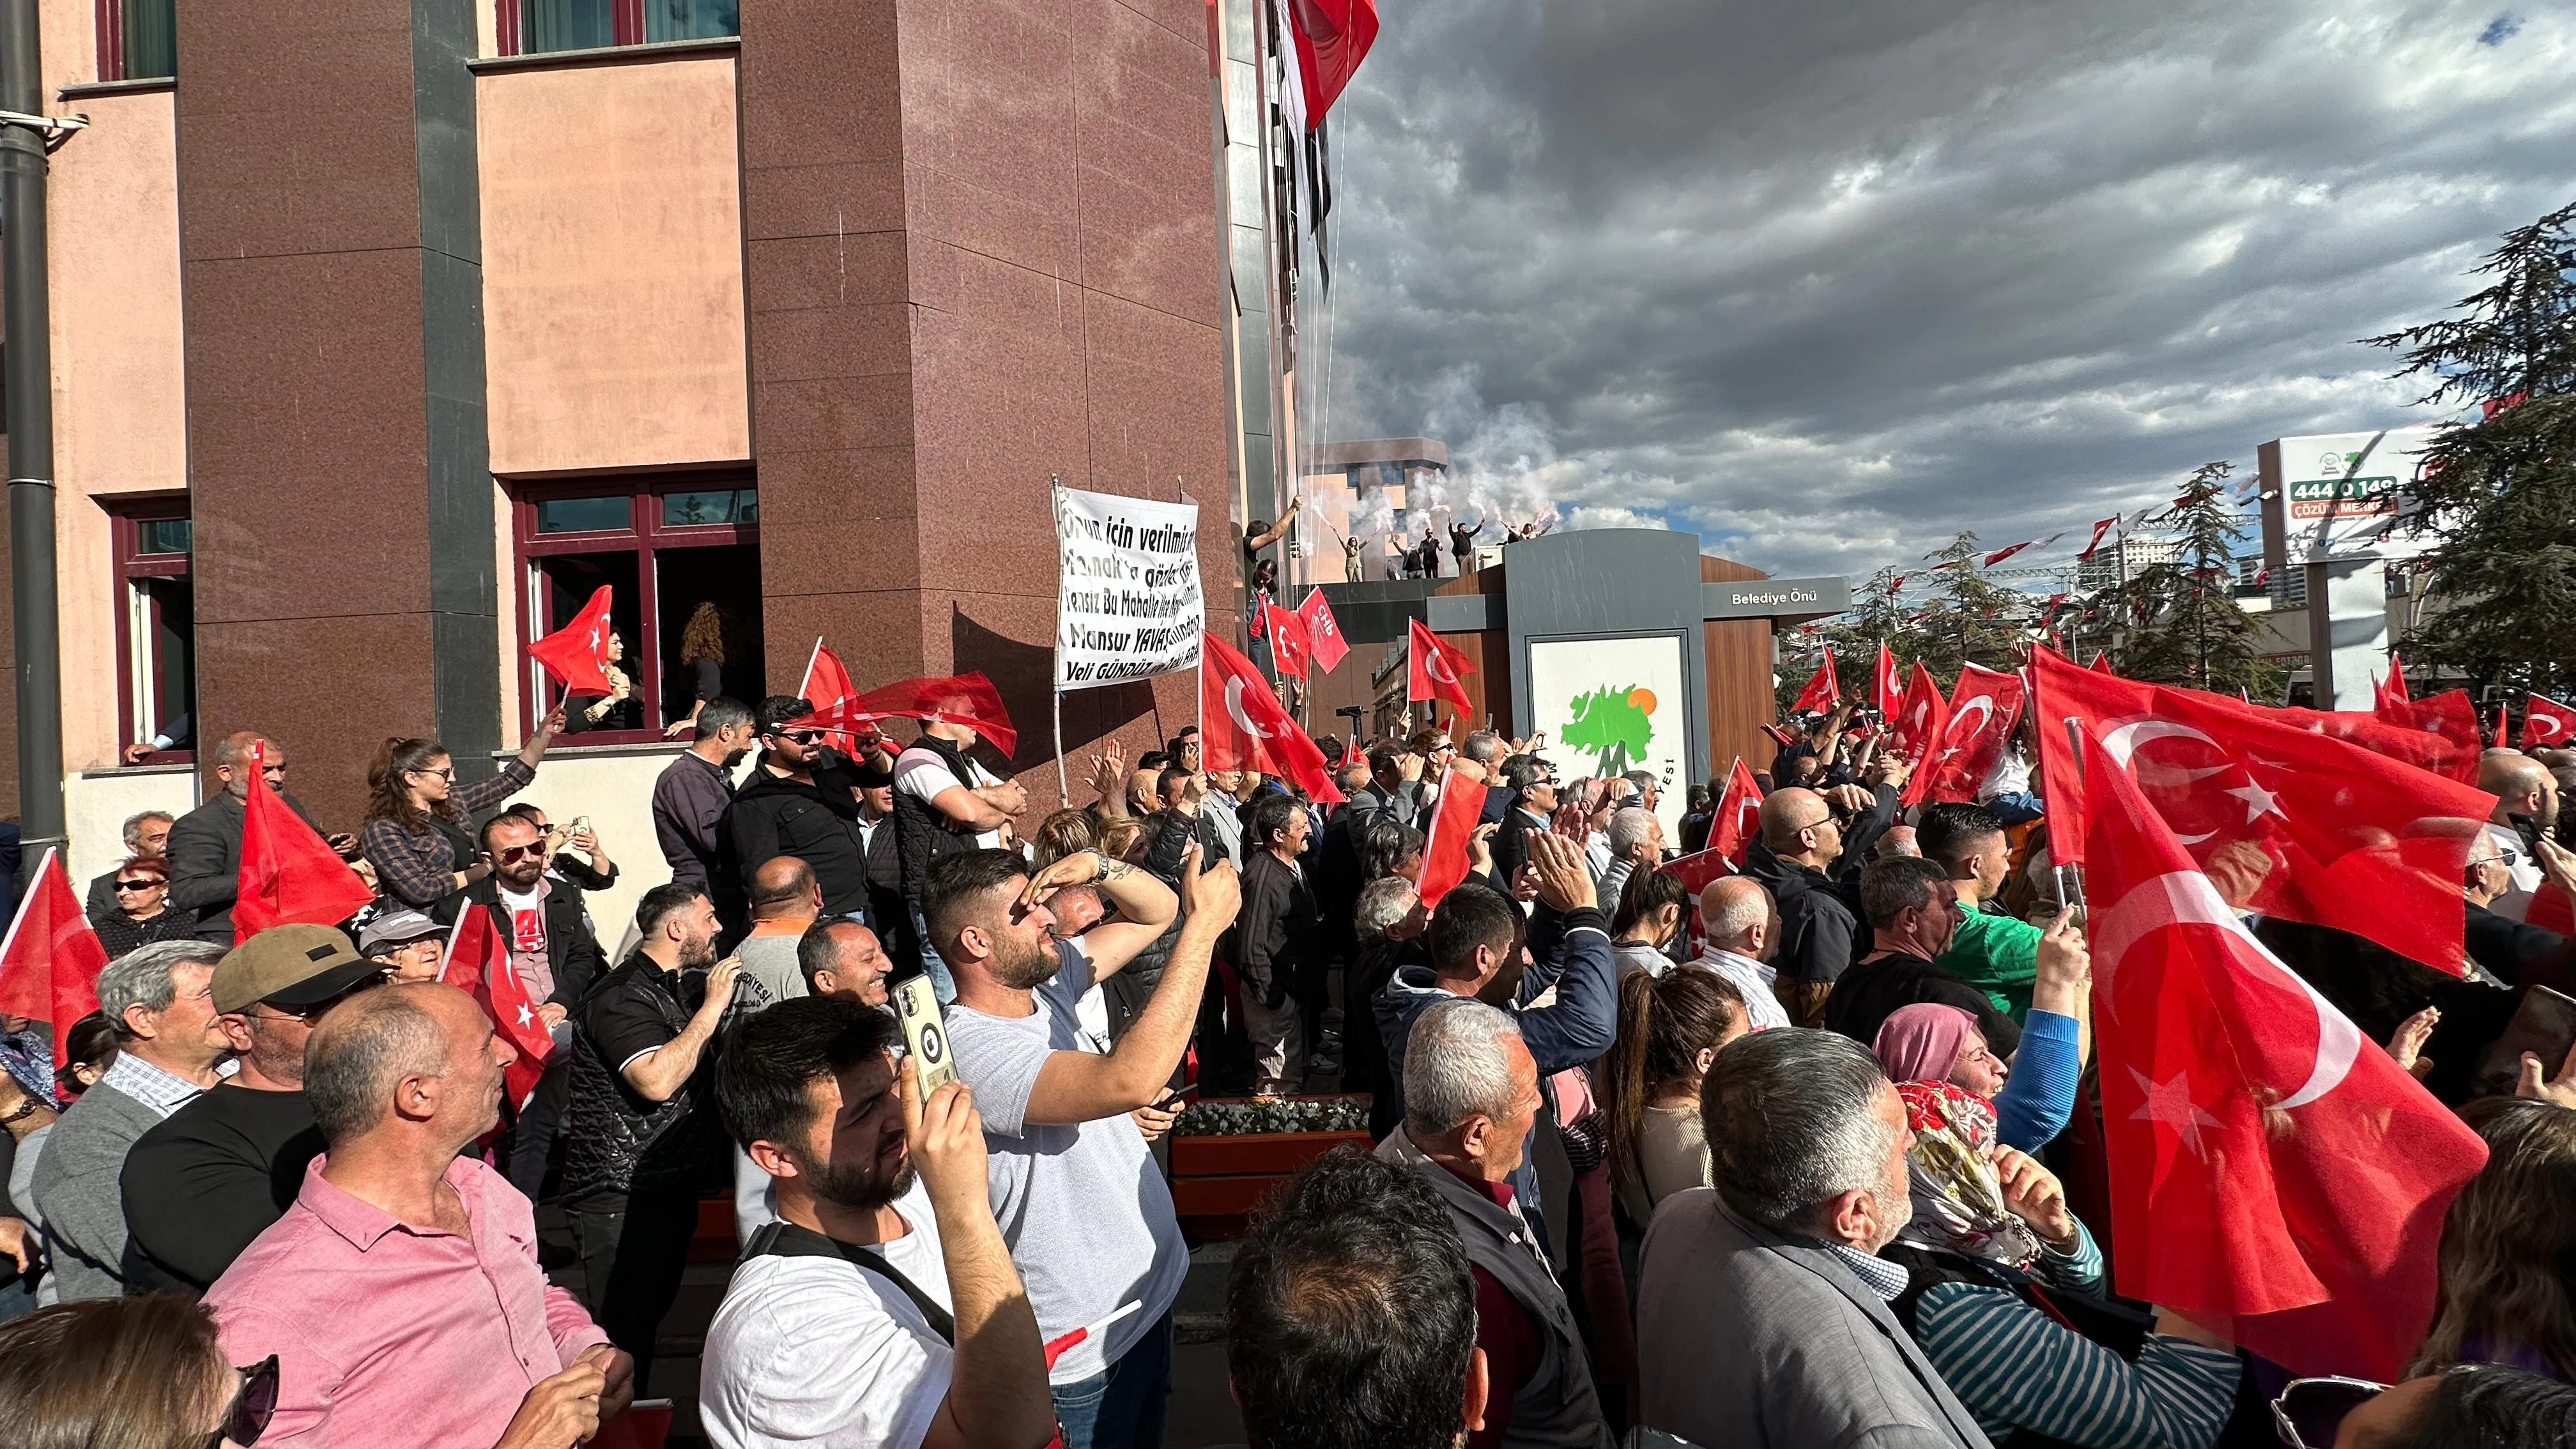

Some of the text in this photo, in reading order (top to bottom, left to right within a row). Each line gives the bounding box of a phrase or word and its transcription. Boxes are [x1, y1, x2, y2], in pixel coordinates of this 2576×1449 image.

[2294, 482, 2334, 499] 444
[2340, 482, 2354, 496] 0
[2294, 502, 2336, 518] ÇÖZÜM
[1104, 588, 1117, 615] Bu
[1121, 588, 1159, 618] Mahalle
[1732, 588, 1817, 606] Belediye Önü
[1070, 623, 1131, 652] Mansur
[1066, 661, 1095, 681] Veli
[1096, 658, 1153, 680] GÜNDÜZ
